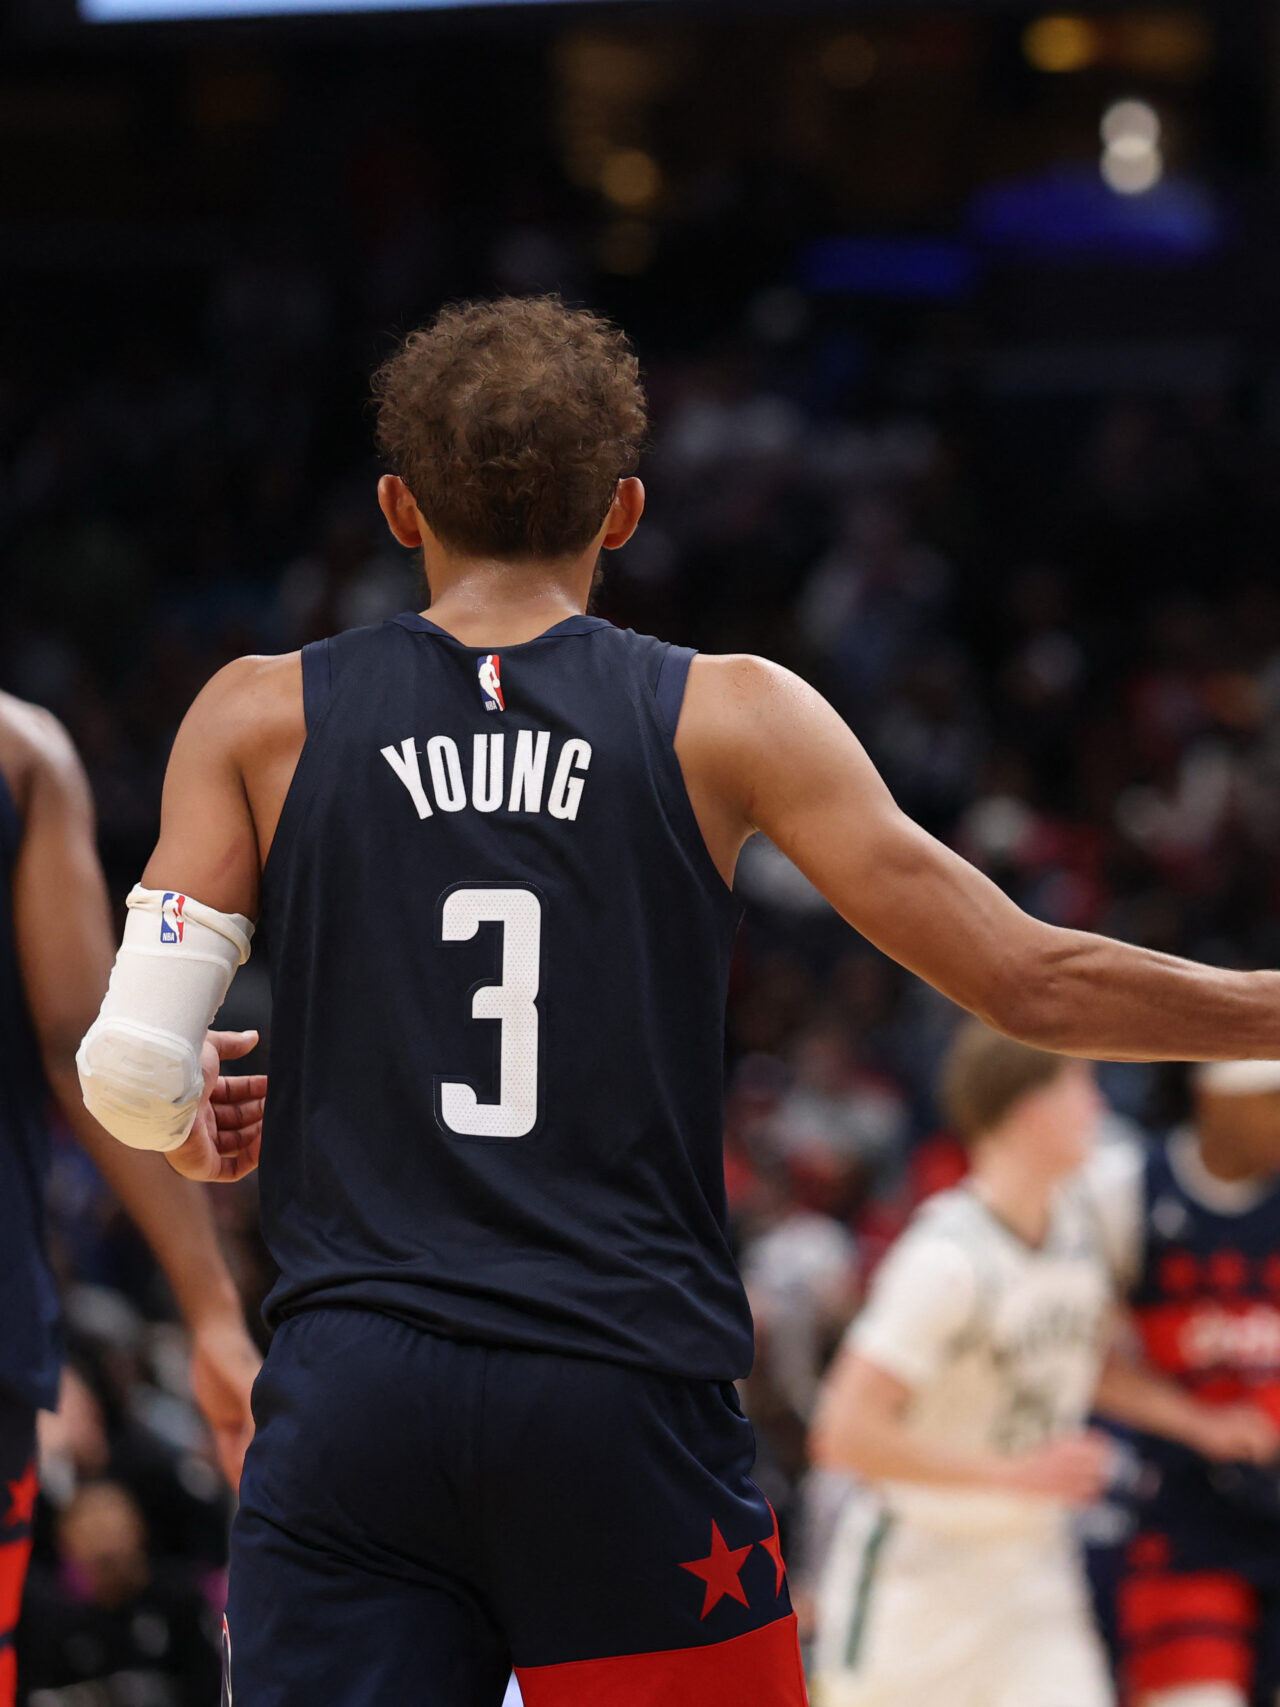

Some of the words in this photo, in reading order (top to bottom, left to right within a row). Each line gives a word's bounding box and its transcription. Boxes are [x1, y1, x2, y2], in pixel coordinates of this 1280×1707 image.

[380, 729, 592, 821] YOUNG
[162, 931, 175, 942] NBA
[441, 888, 541, 1138] 3
